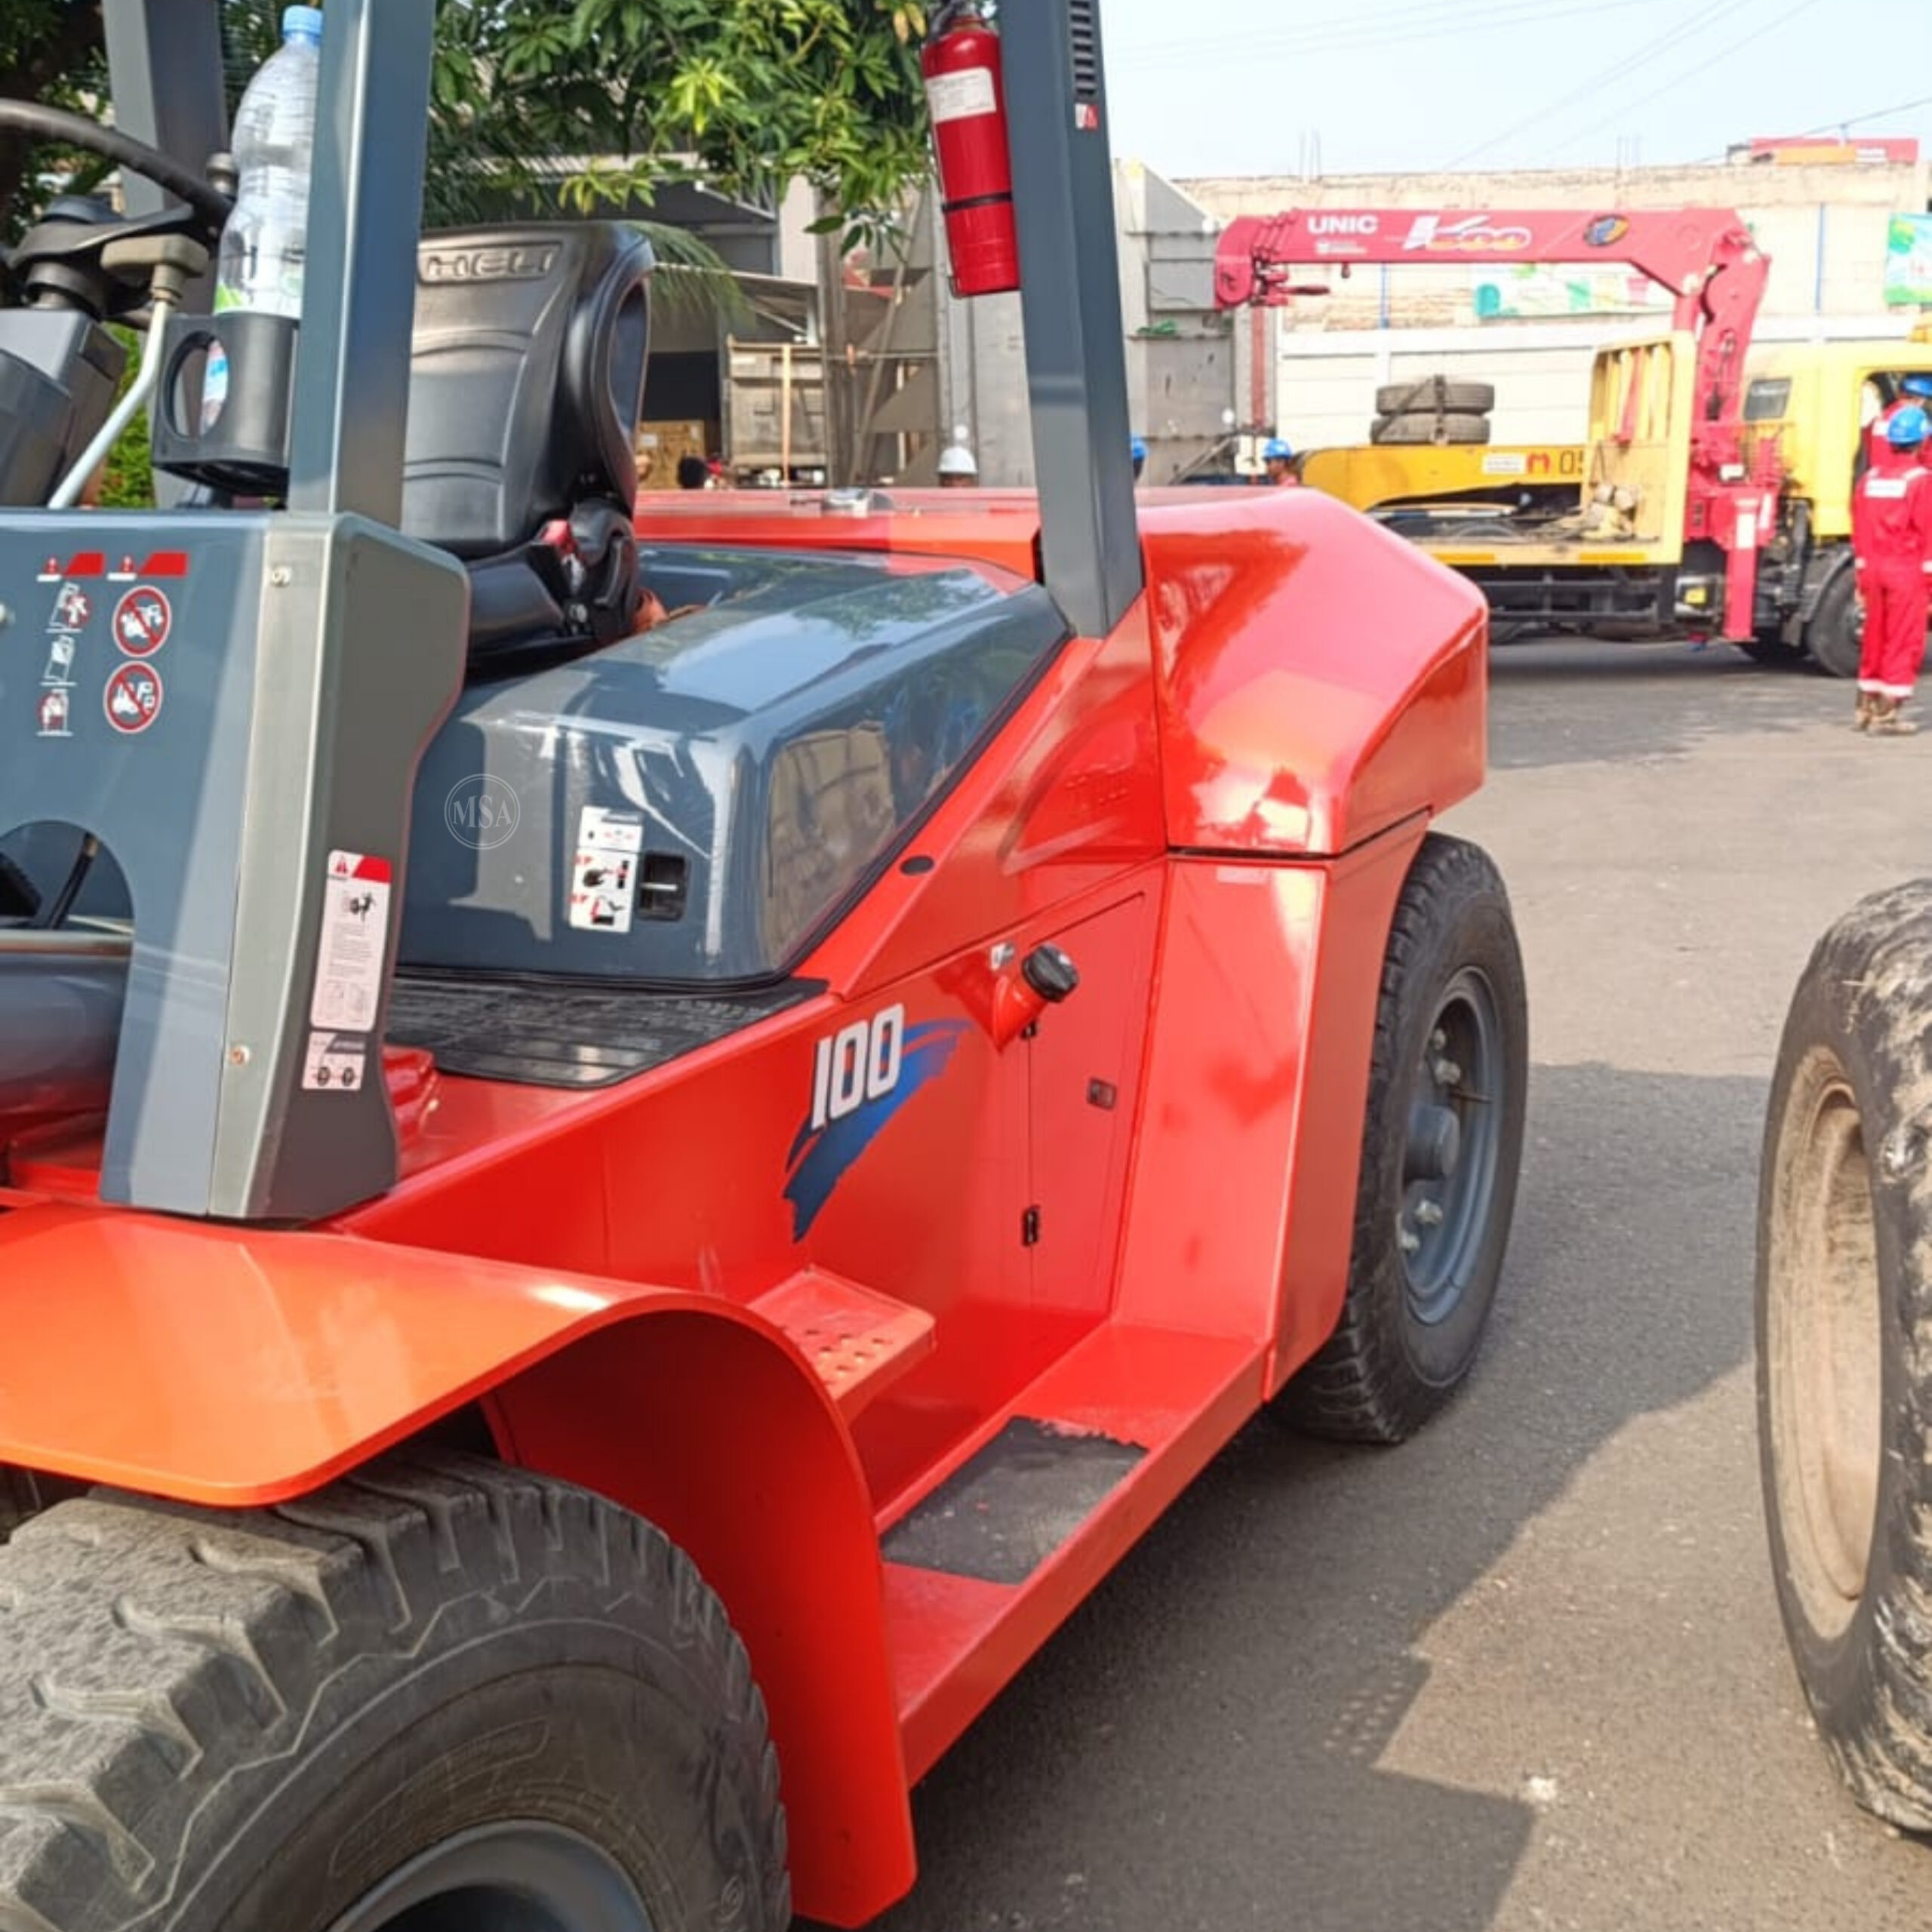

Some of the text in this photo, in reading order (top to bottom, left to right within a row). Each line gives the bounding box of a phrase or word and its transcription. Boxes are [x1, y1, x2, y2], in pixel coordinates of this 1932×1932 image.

[1307, 215, 1378, 234] UNIC
[426, 251, 554, 278] HELI
[811, 1002, 905, 1131] 100
